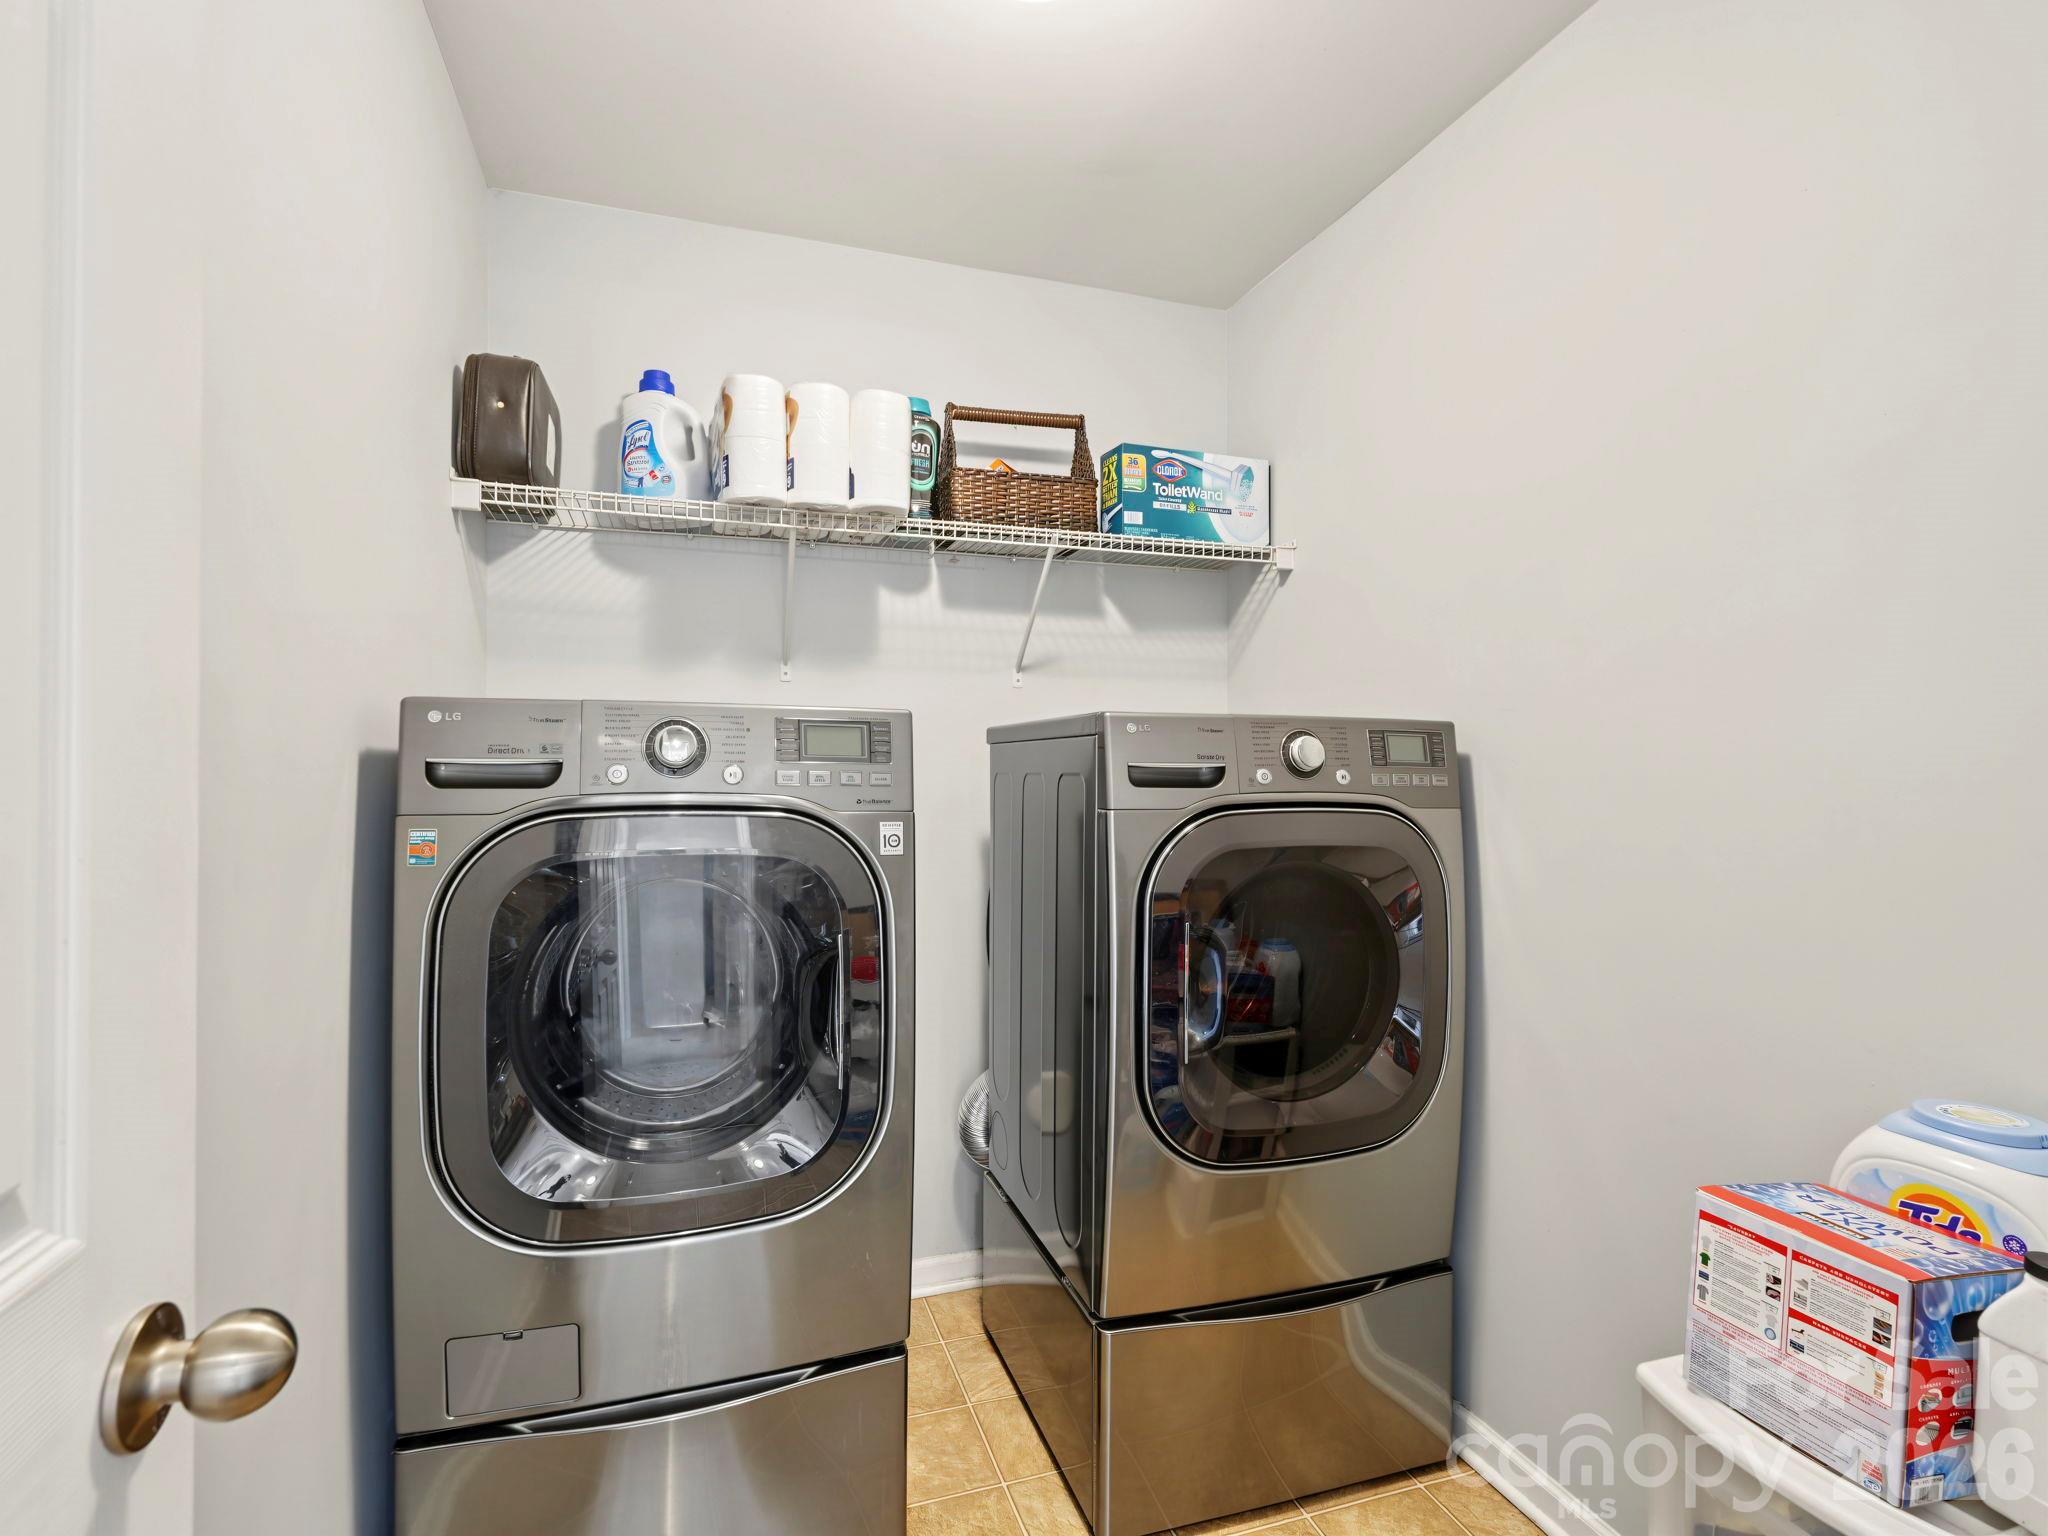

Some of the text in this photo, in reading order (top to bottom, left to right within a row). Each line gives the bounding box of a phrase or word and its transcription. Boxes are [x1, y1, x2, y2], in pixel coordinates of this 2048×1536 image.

[1103, 461, 1118, 486] 2X
[1157, 465, 1183, 477] CLOROX
[1152, 482, 1223, 502] ToiletWand
[445, 712, 462, 721] LG
[1138, 724, 1151, 732] LG
[487, 747, 510, 755] Direct
